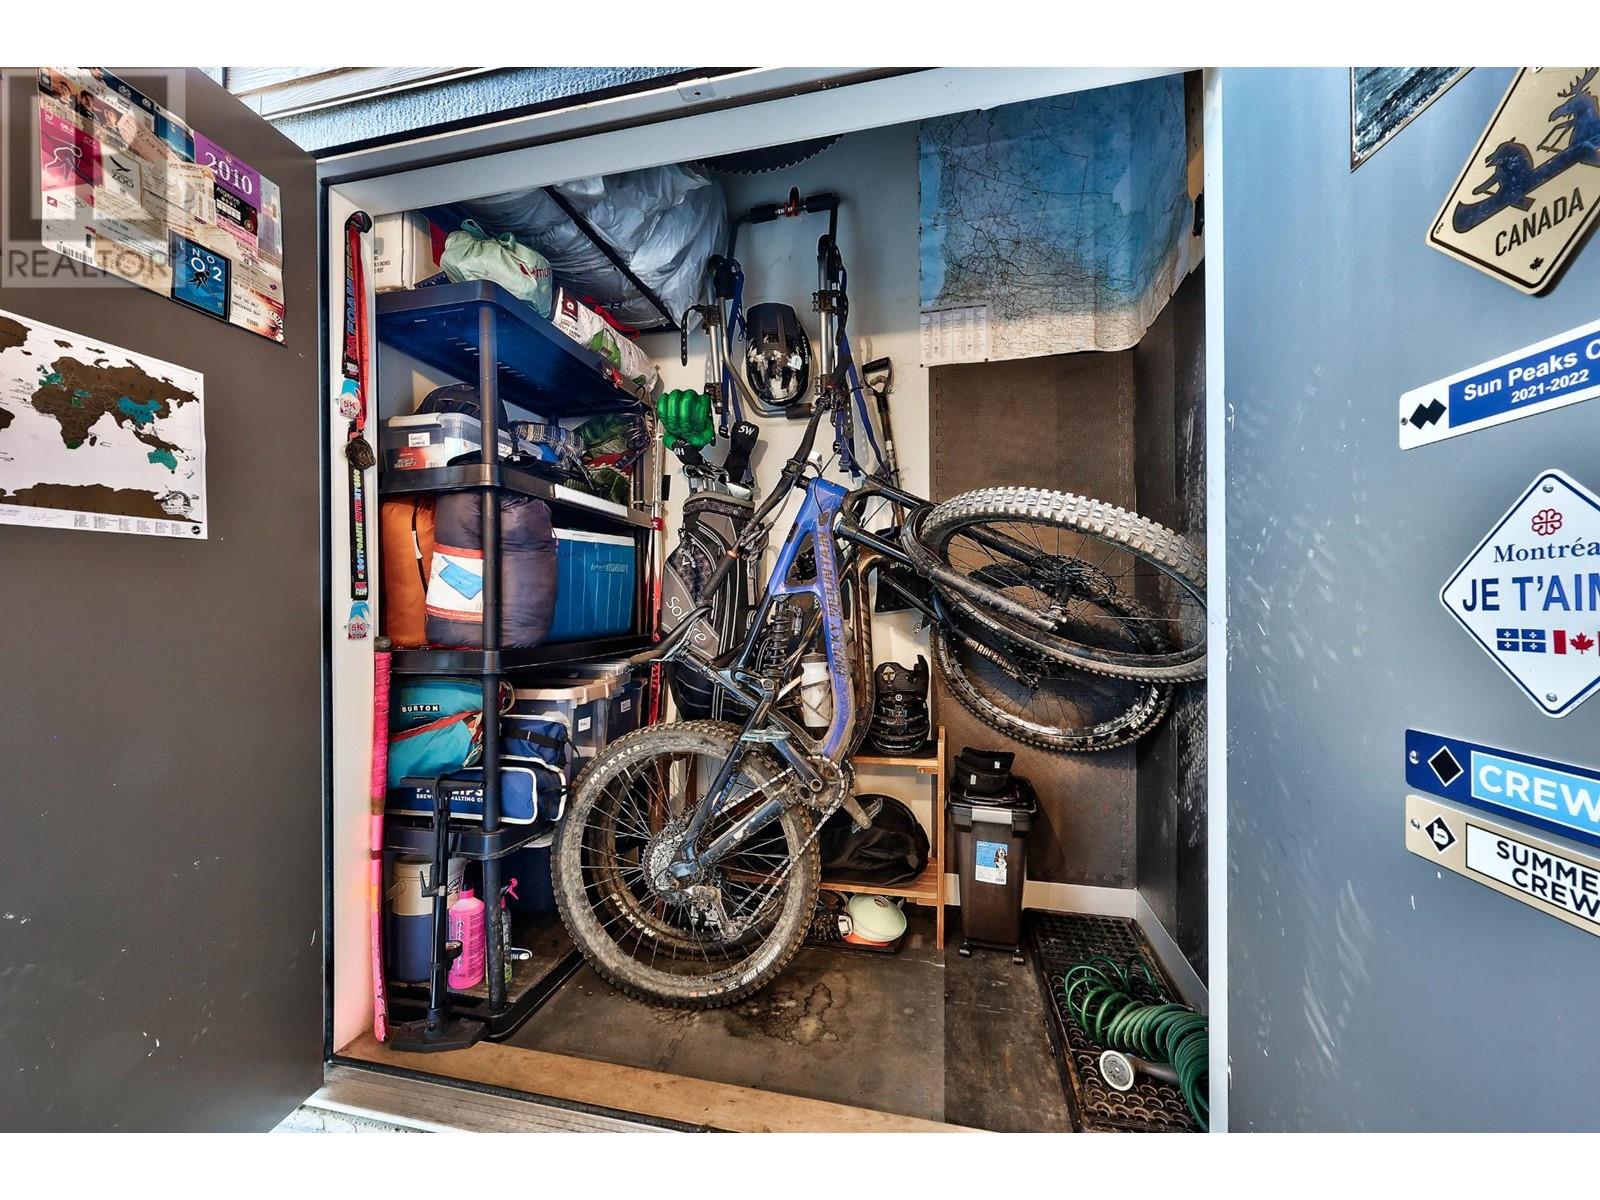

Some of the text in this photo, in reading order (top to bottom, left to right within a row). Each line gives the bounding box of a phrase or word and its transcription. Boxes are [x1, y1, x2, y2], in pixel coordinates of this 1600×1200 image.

[112, 173, 135, 189] ZOO
[205, 152, 252, 195] 2010
[1495, 187, 1584, 256] CANADA
[1464, 378, 1502, 401] Sun
[1508, 352, 1578, 387] Peaks
[1511, 368, 1590, 403] 2021-2022
[738, 425, 756, 436] SW
[1462, 577, 1500, 612] JE
[401, 704, 439, 713] BURTON
[1130, 685, 1158, 729] MAXXIS
[590, 744, 641, 784] MAXXIS
[1479, 764, 1600, 823] CREW
[1496, 840, 1598, 896] SUMME
[1512, 867, 1600, 918] CREW
[611, 893, 656, 937] MAXXIS
